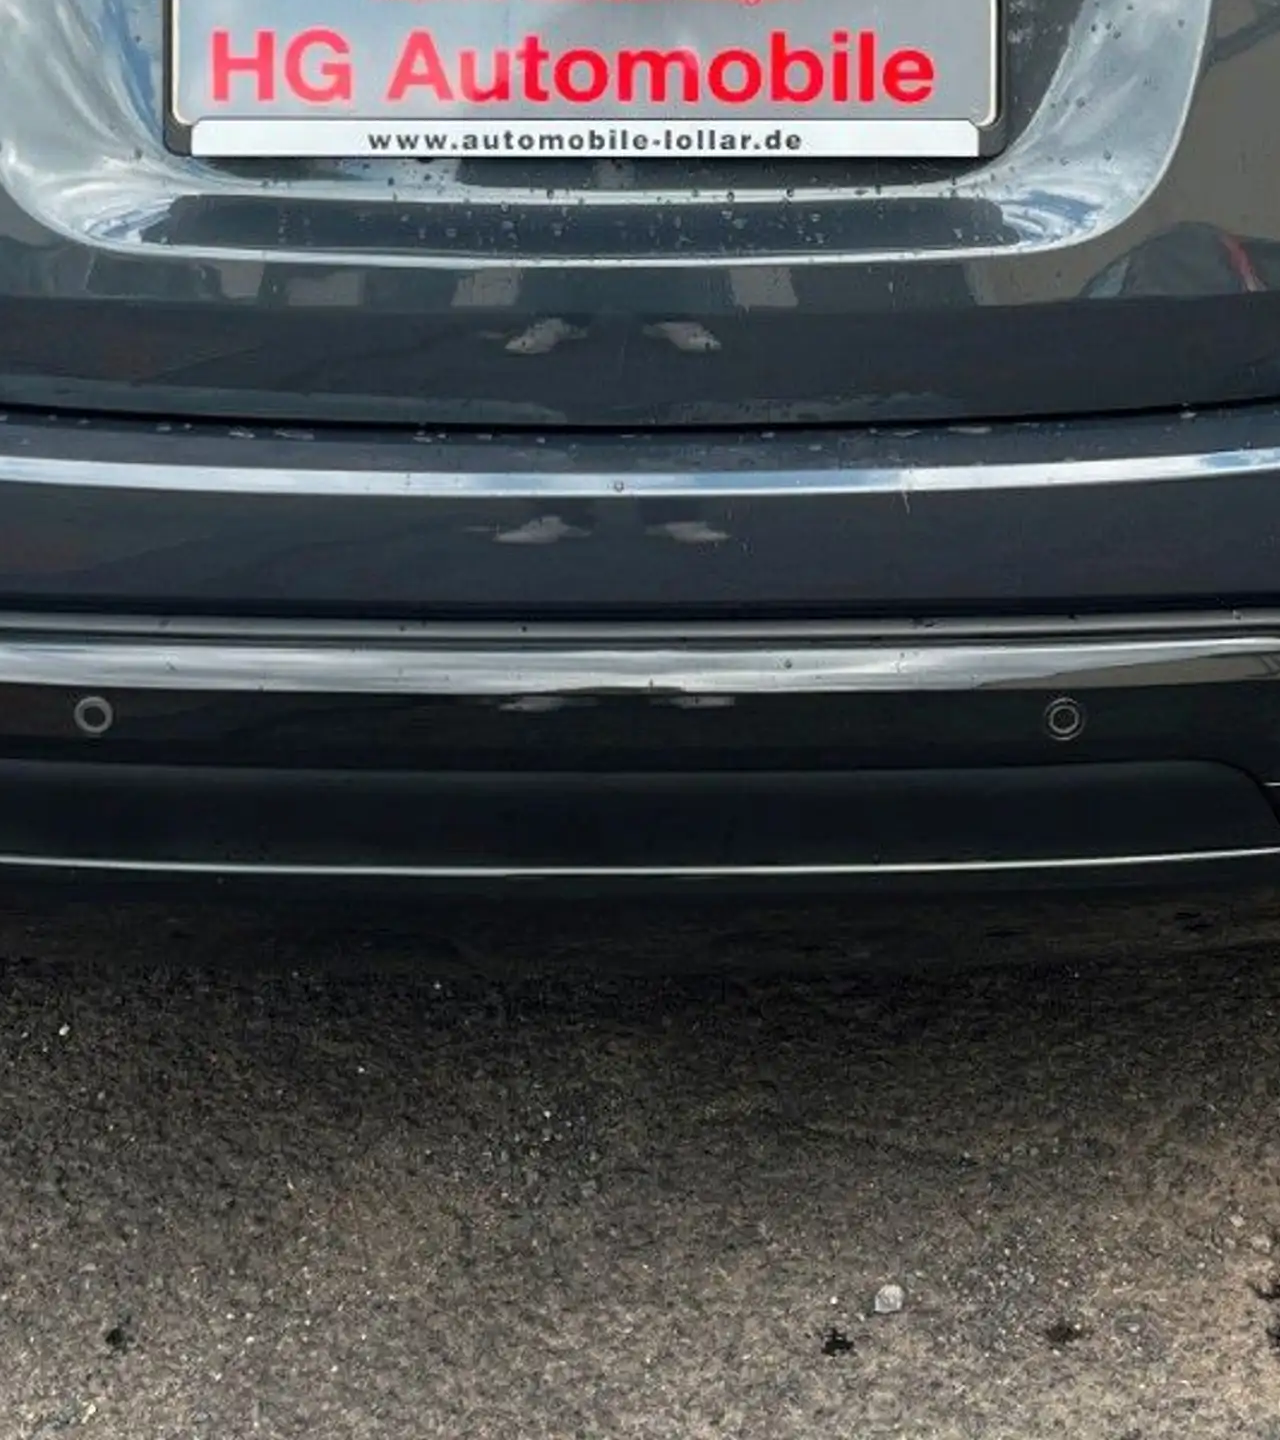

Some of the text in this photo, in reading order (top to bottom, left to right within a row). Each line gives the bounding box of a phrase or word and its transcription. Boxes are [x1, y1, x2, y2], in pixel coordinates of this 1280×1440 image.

[212, 28, 935, 103] HG Automobile
[368, 129, 803, 151] www.automobile-lollar.de
